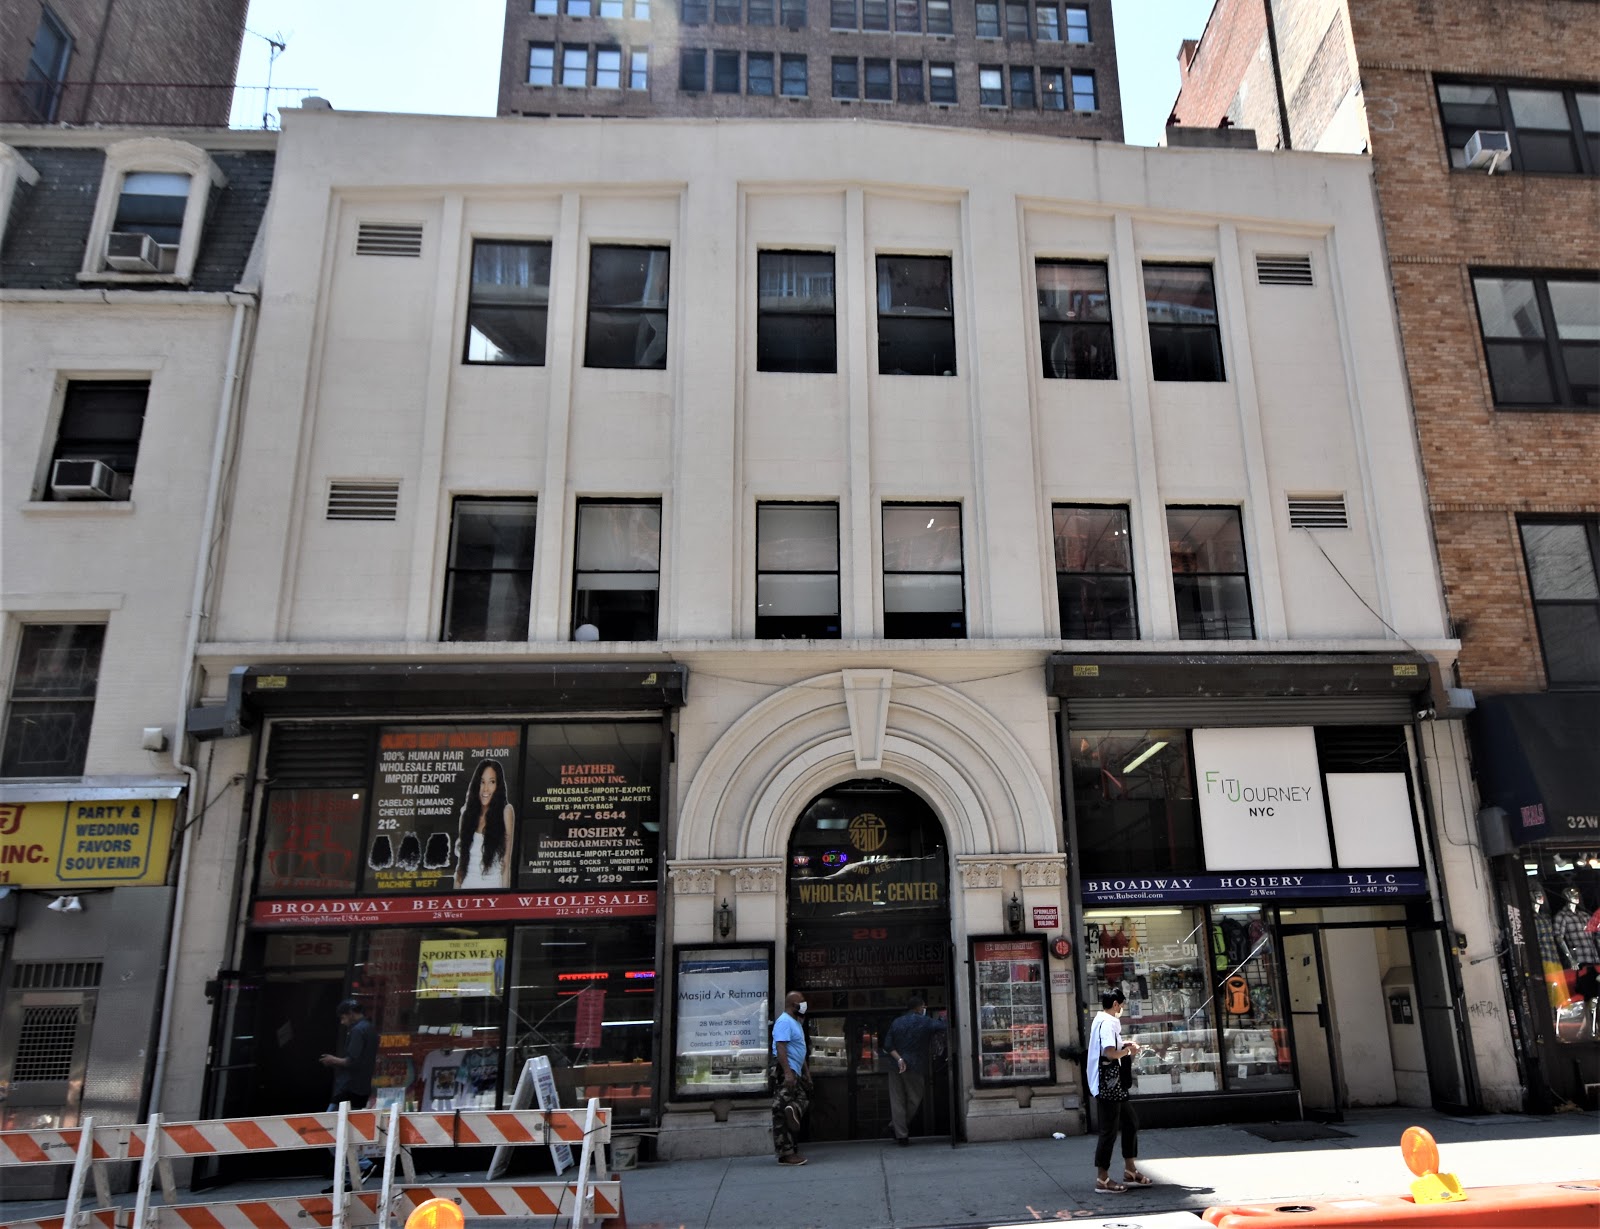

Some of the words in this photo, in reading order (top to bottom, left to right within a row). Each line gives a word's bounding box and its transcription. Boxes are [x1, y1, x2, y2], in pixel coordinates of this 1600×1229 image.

[383, 752, 405, 761] 100%
[408, 751, 440, 760] HUMAN
[443, 750, 464, 760] HAIR
[471, 749, 484, 758] 2nd
[485, 748, 510, 757] FLOOR
[379, 762, 432, 772] WHOLESALE
[434, 762, 465, 772] RETAIL
[561, 764, 616, 775] LEATHER
[385, 773, 418, 784] IMPORT
[421, 773, 457, 783] EXPORT
[561, 776, 605, 785] FASHION
[607, 775, 628, 784] INC.
[401, 784, 440, 794] TRADING
[377, 798, 414, 807] CABELOS
[416, 798, 454, 806] HUMANOS
[77, 806, 125, 819] PARTY
[131, 806, 140, 818] &
[378, 808, 414, 816] CHEVEUX
[417, 807, 452, 816] HUMAINS
[558, 812, 582, 820] 447
[594, 811, 626, 820] 6544
[1249, 807, 1274, 817] NYC
[76, 823, 140, 836] WEDDING
[567, 827, 626, 838] HOSIERY
[77, 839, 132, 852] FAVORS
[539, 839, 623, 848] UNDERGARMENTS
[625, 838, 643, 846] INC.
[0, 844, 49, 864] INC.
[821, 854, 848, 862] OPN
[65, 856, 140, 870] SOUVENIR
[377, 880, 412, 888] MACHINE
[415, 879, 438, 888] WEFT
[557, 875, 580, 884] 447
[596, 874, 623, 883] 1299
[1088, 879, 1194, 892] BROADWAY
[1220, 876, 1304, 888] HOSIERY
[799, 883, 880, 904] WHOLESALE
[887, 882, 938, 900] CENTER
[270, 900, 393, 914] BROADWAY
[412, 897, 499, 910] BEAUTY
[518, 894, 650, 907] WHOLESALE
[279, 915, 379, 924] www.ShopMoreUSA.com
[444, 911, 463, 919] West
[422, 950, 466, 960] SPORTS
[469, 949, 504, 958] WEAR
[1094, 947, 1154, 959] WHOLESALE
[678, 990, 711, 1002] Masjid
[714, 990, 725, 999] Ar
[728, 989, 768, 999] Rahman
